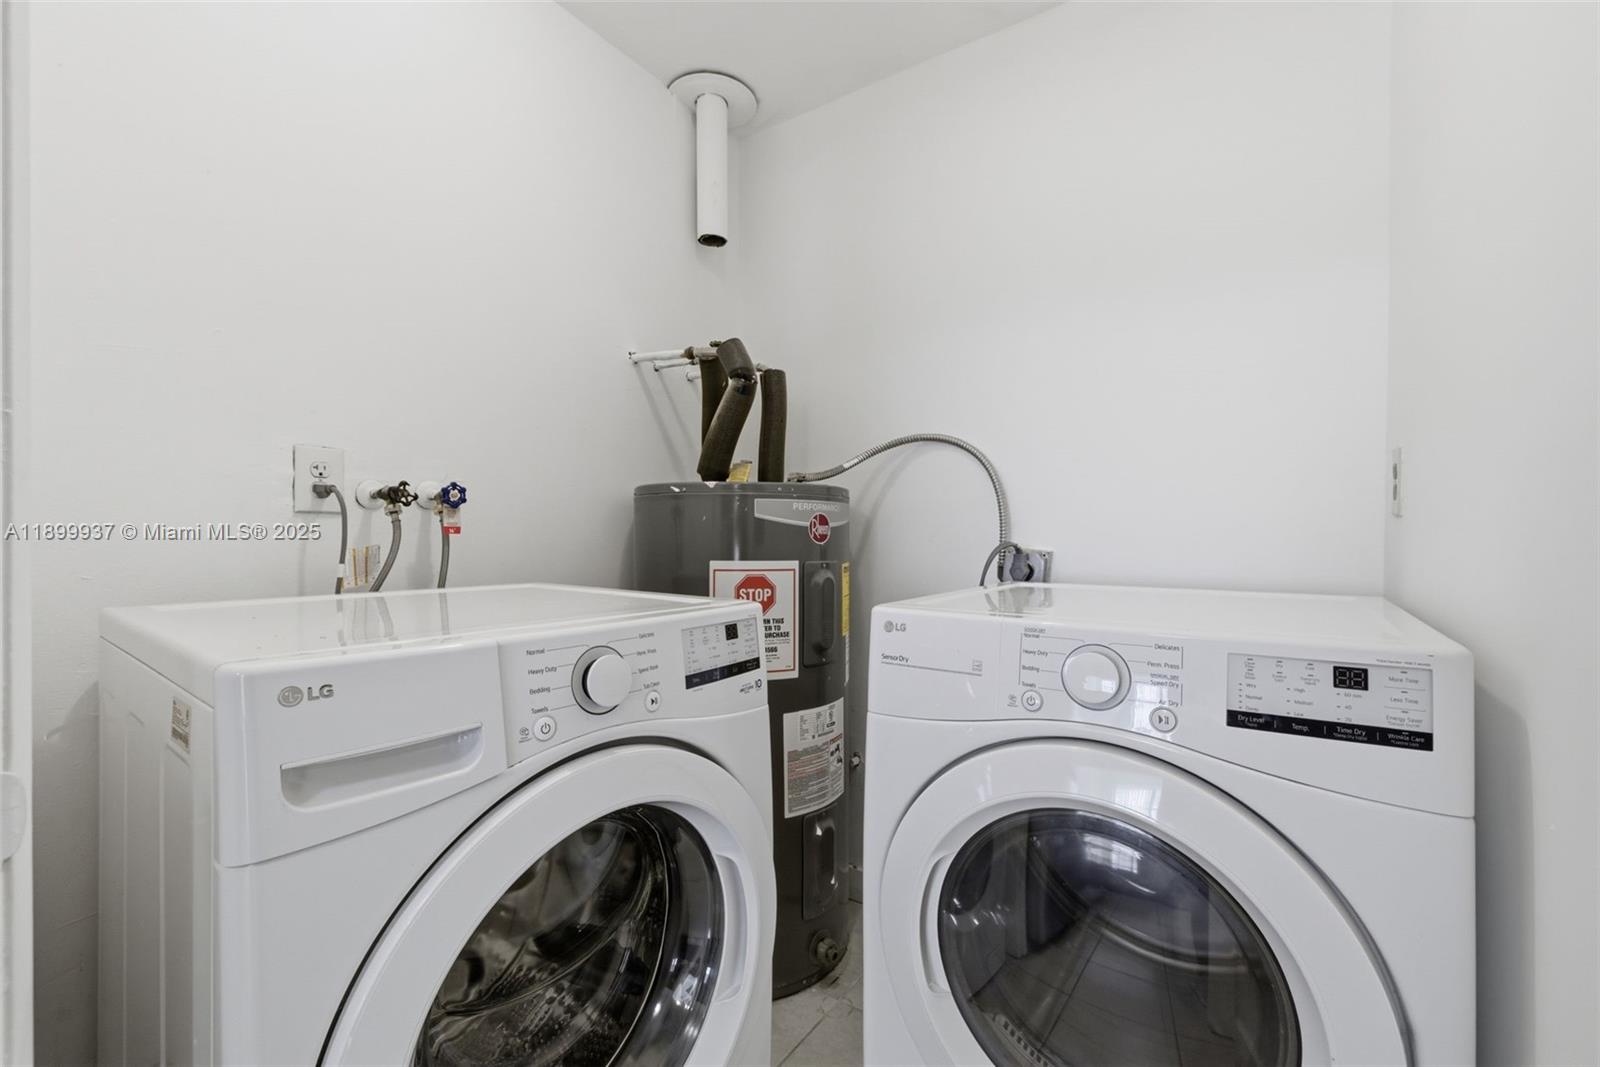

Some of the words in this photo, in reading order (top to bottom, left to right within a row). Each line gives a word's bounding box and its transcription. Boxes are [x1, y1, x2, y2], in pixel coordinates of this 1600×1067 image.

[739, 588, 772, 602] STOP
[894, 623, 906, 632] LG
[1154, 643, 1180, 651] Delicates
[307, 684, 334, 701] LG
[1168, 700, 1179, 708] Dry
[1238, 714, 1248, 724] Dry
[1292, 723, 1310, 732] Temp.
[1336, 726, 1352, 734] Time
[1354, 728, 1366, 736] Dry
